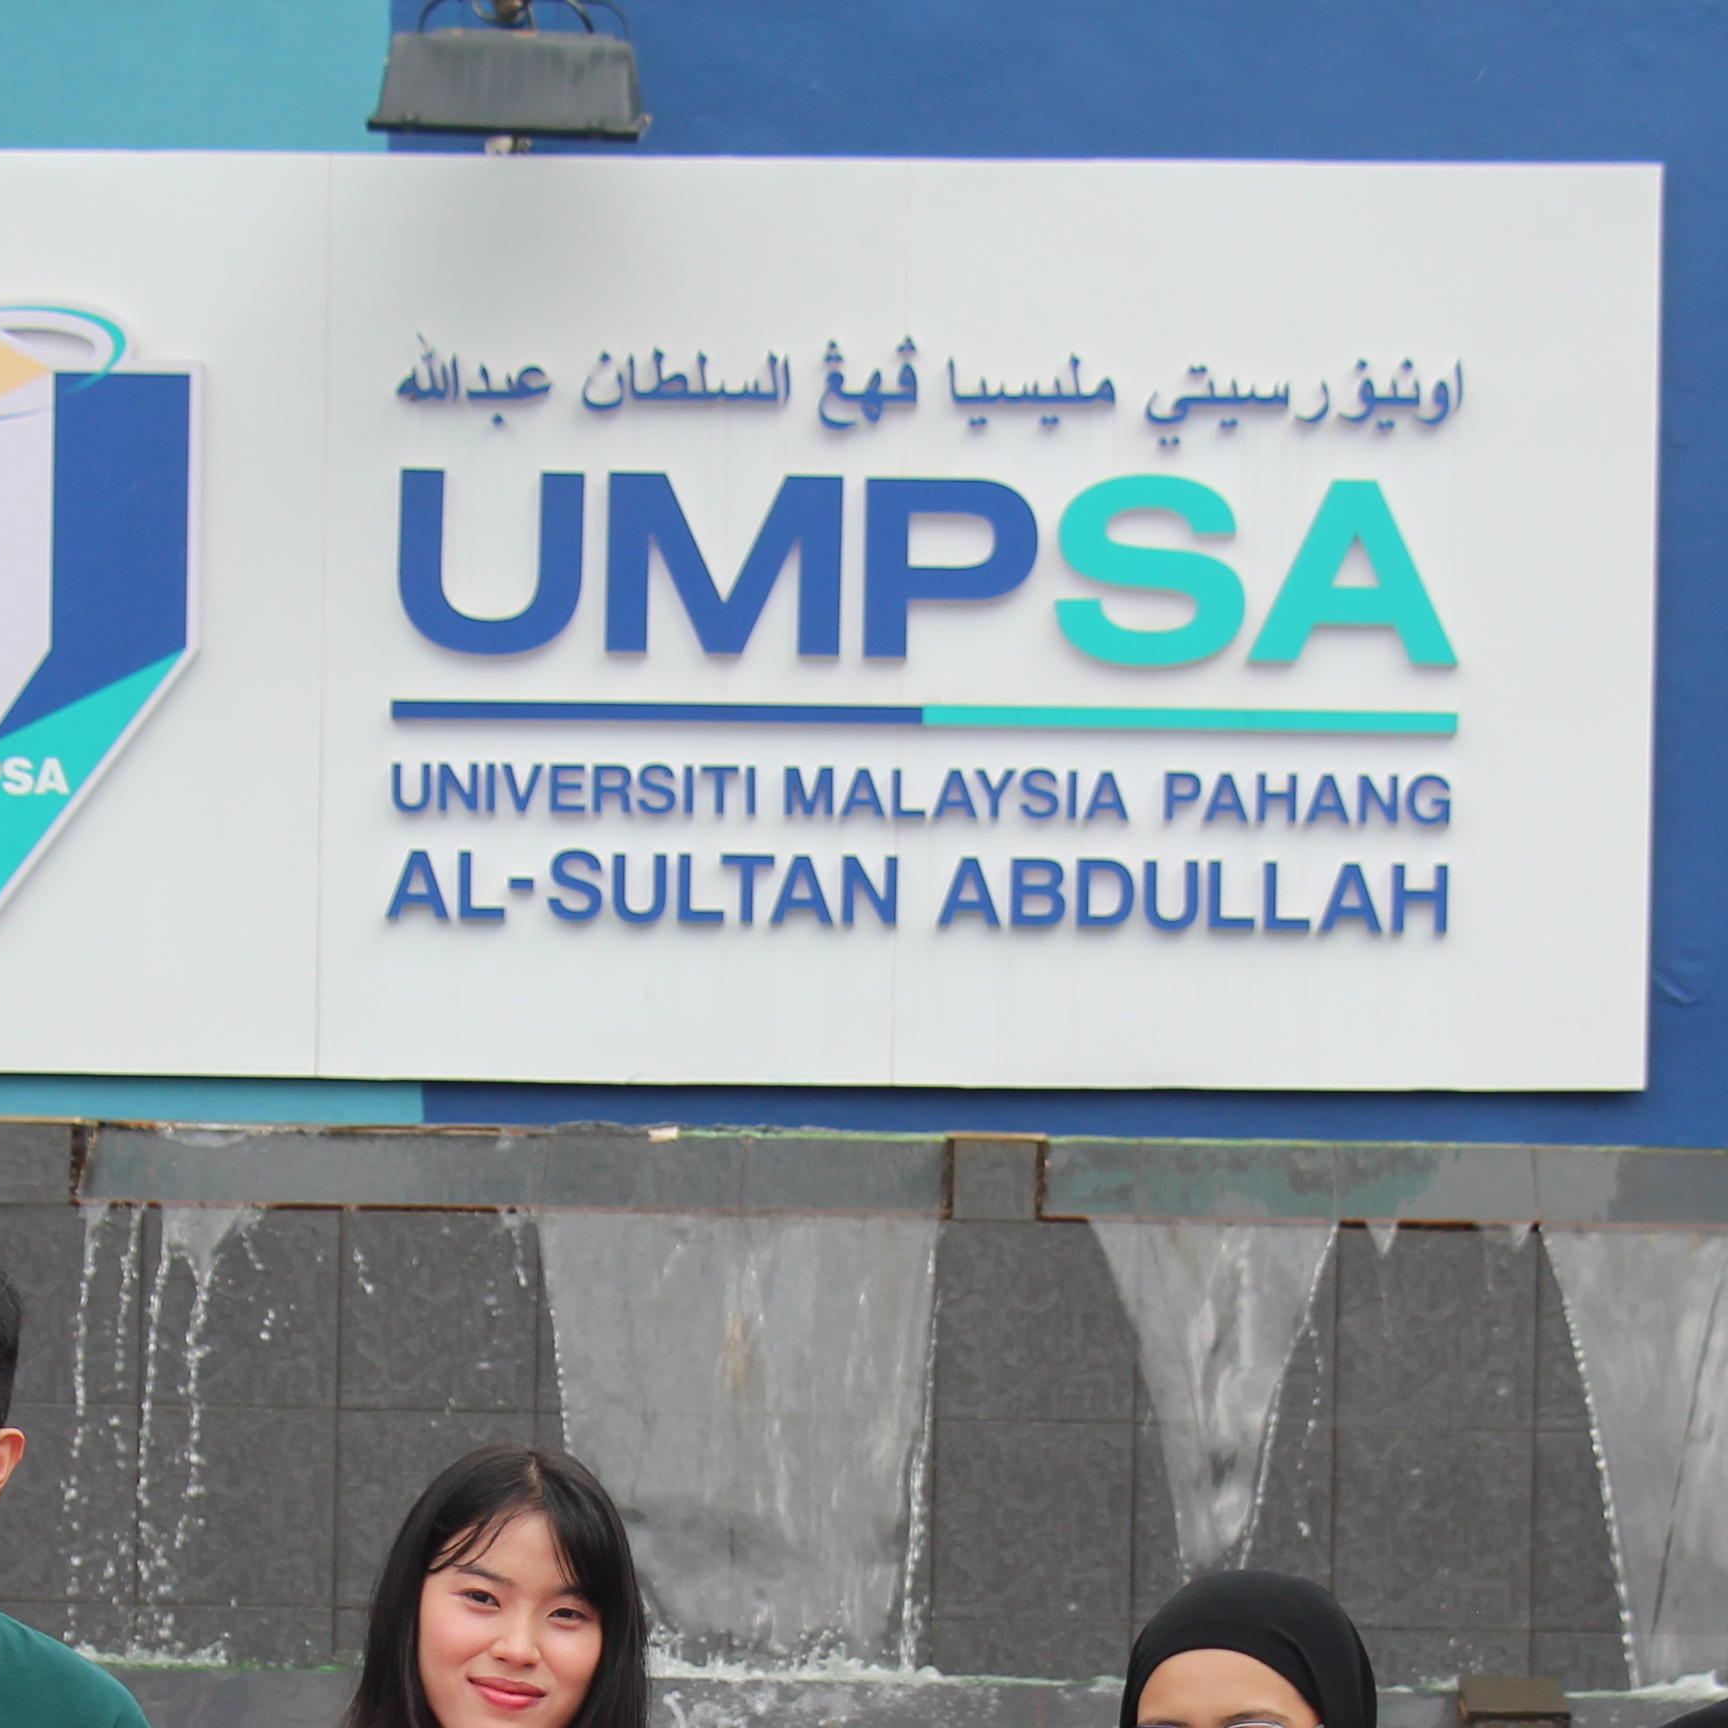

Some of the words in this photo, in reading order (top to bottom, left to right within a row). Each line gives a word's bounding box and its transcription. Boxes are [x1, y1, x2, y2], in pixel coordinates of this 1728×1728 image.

[395, 331, 553, 426] عبدالله
[582, 345, 790, 411] السلطان
[947, 352, 1116, 427] مليسيا
[396, 467, 1460, 667] UMPSA
[390, 762, 757, 815] UNIVERSITI
[783, 766, 1129, 821] MALAYSIA
[1163, 771, 1452, 826] PAHANG
[386, 849, 898, 926] AL-SULTAN
[936, 855, 1450, 933] ABDULLAH
